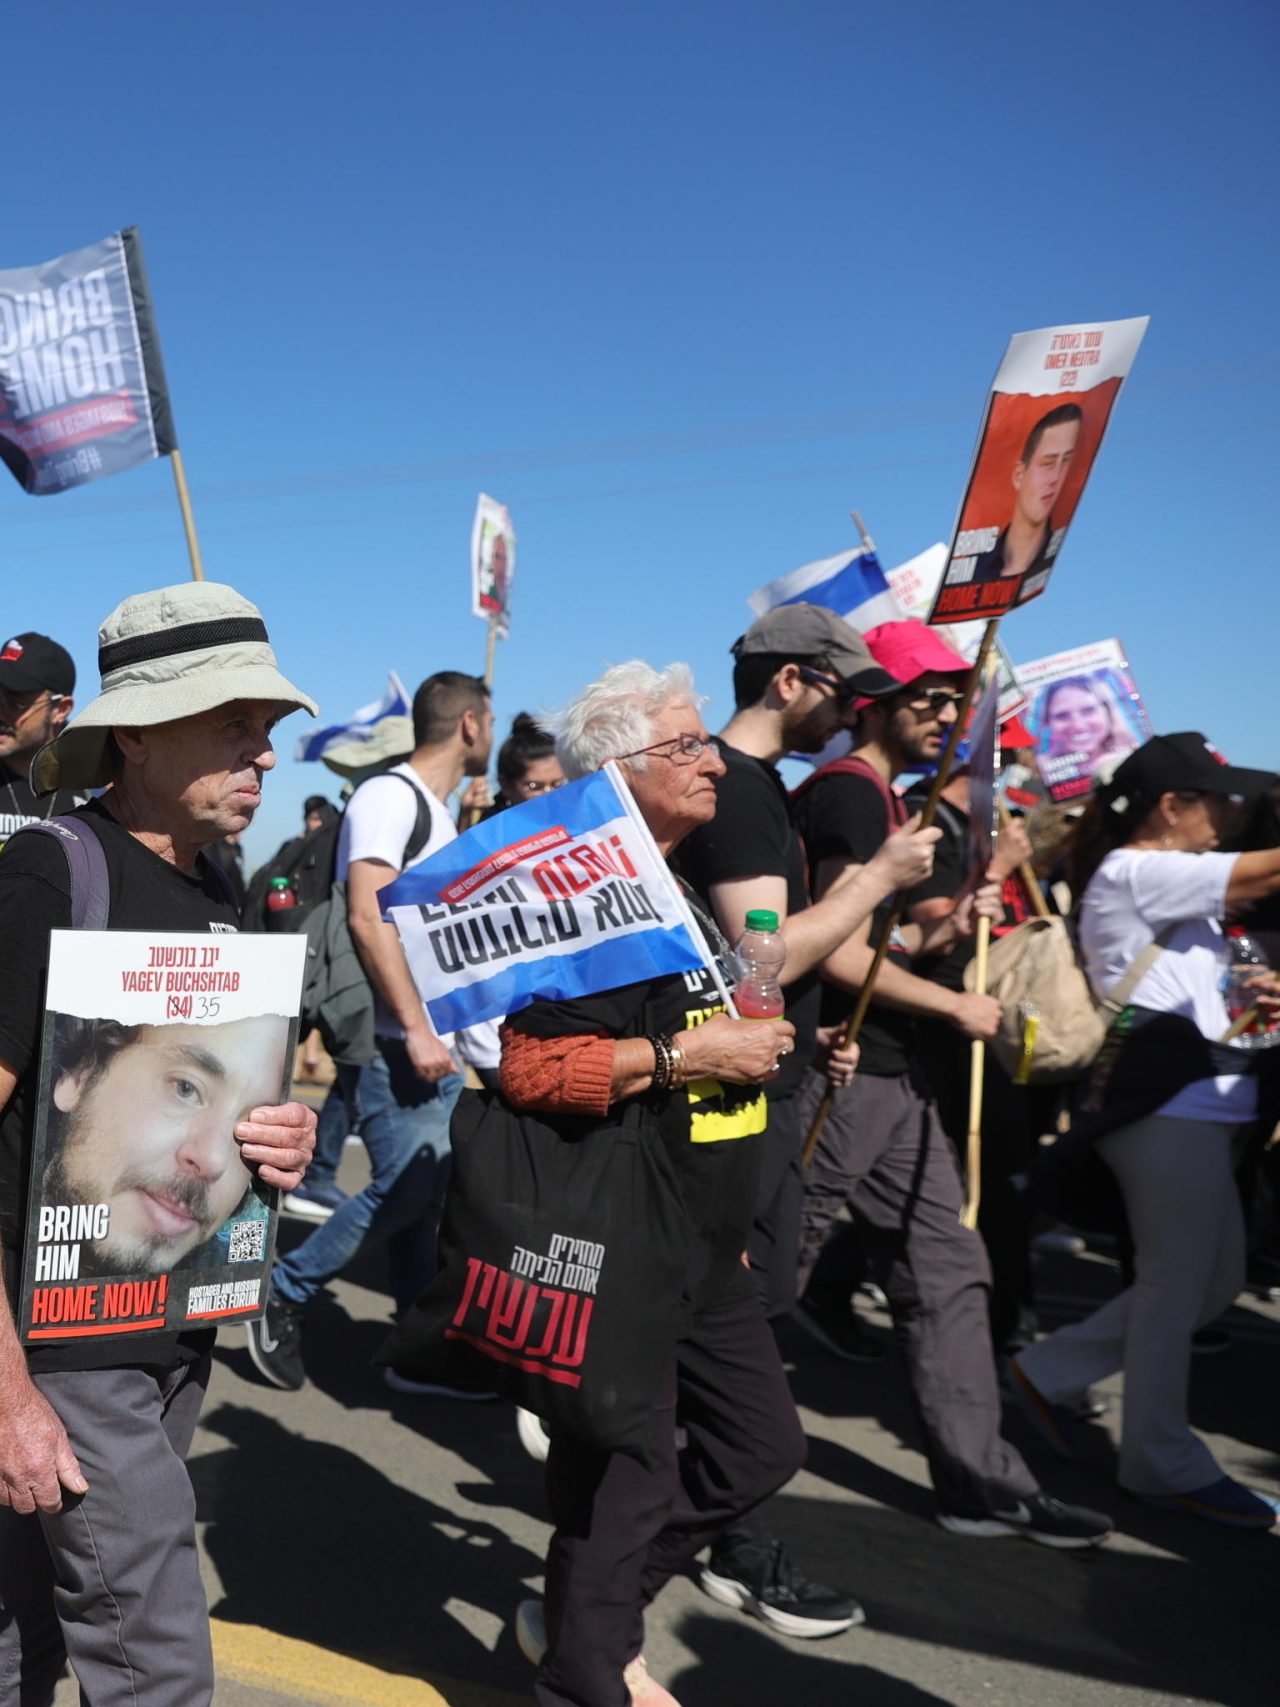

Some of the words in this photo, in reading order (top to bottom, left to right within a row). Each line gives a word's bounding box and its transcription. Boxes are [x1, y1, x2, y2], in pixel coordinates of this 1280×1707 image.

[429, 898, 582, 974] מחזירים
[147, 946, 196, 968] בוכשטב
[200, 946, 220, 968] יגב
[122, 971, 163, 992] YAGEV
[165, 971, 240, 992] BUCHSHTAB
[195, 996, 223, 1019] 35
[38, 1203, 110, 1243] BRING
[35, 1244, 81, 1282] HIM
[510, 1245, 564, 1287] הביתה
[549, 1233, 606, 1270] מחזירים
[189, 1282, 221, 1299] HOSTAGES
[220, 1280, 235, 1295] AND
[234, 1278, 261, 1294] MISSING
[562, 1262, 600, 1295] אותם
[32, 1284, 99, 1324] HOME
[103, 1274, 169, 1319] NOW!
[187, 1294, 229, 1316] FAMILIES
[228, 1289, 260, 1311] FORUM
[452, 1257, 595, 1368] עכשיו
